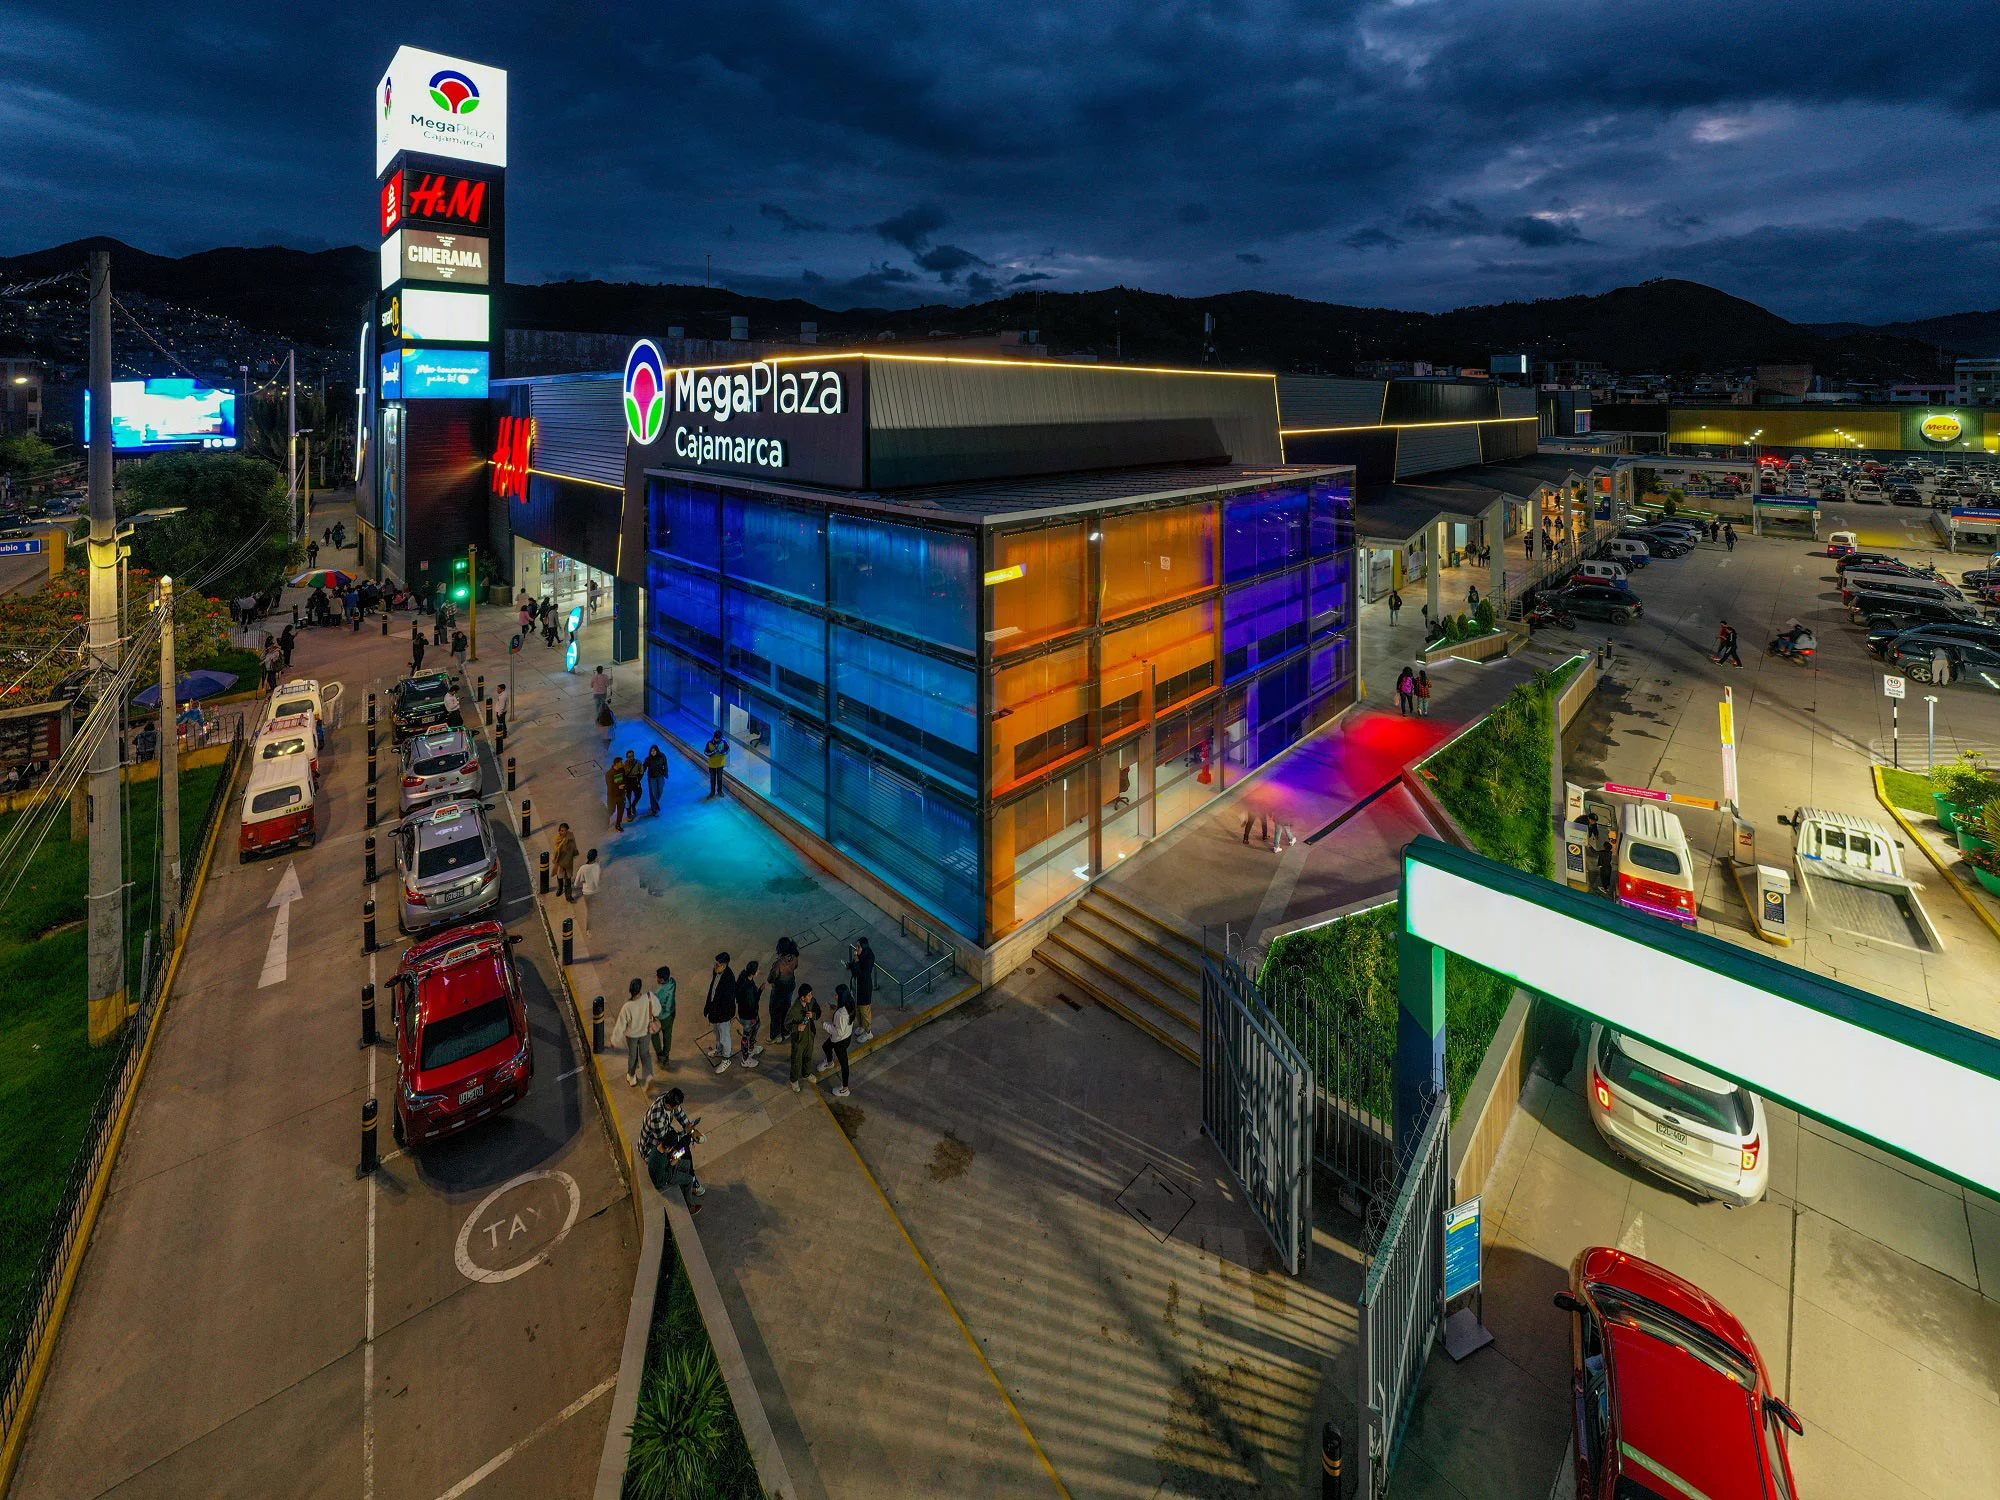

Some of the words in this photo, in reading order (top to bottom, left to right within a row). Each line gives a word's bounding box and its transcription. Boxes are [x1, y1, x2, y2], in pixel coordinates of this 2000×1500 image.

[411, 114, 495, 140] MegaPlaza
[423, 130, 483, 149] Cajamarca
[409, 174, 486, 223] H&M
[407, 245, 482, 268] CINERAMA
[675, 361, 842, 422] MegaPlaza
[493, 416, 531, 504] H&M
[675, 426, 782, 467] Cajamarca
